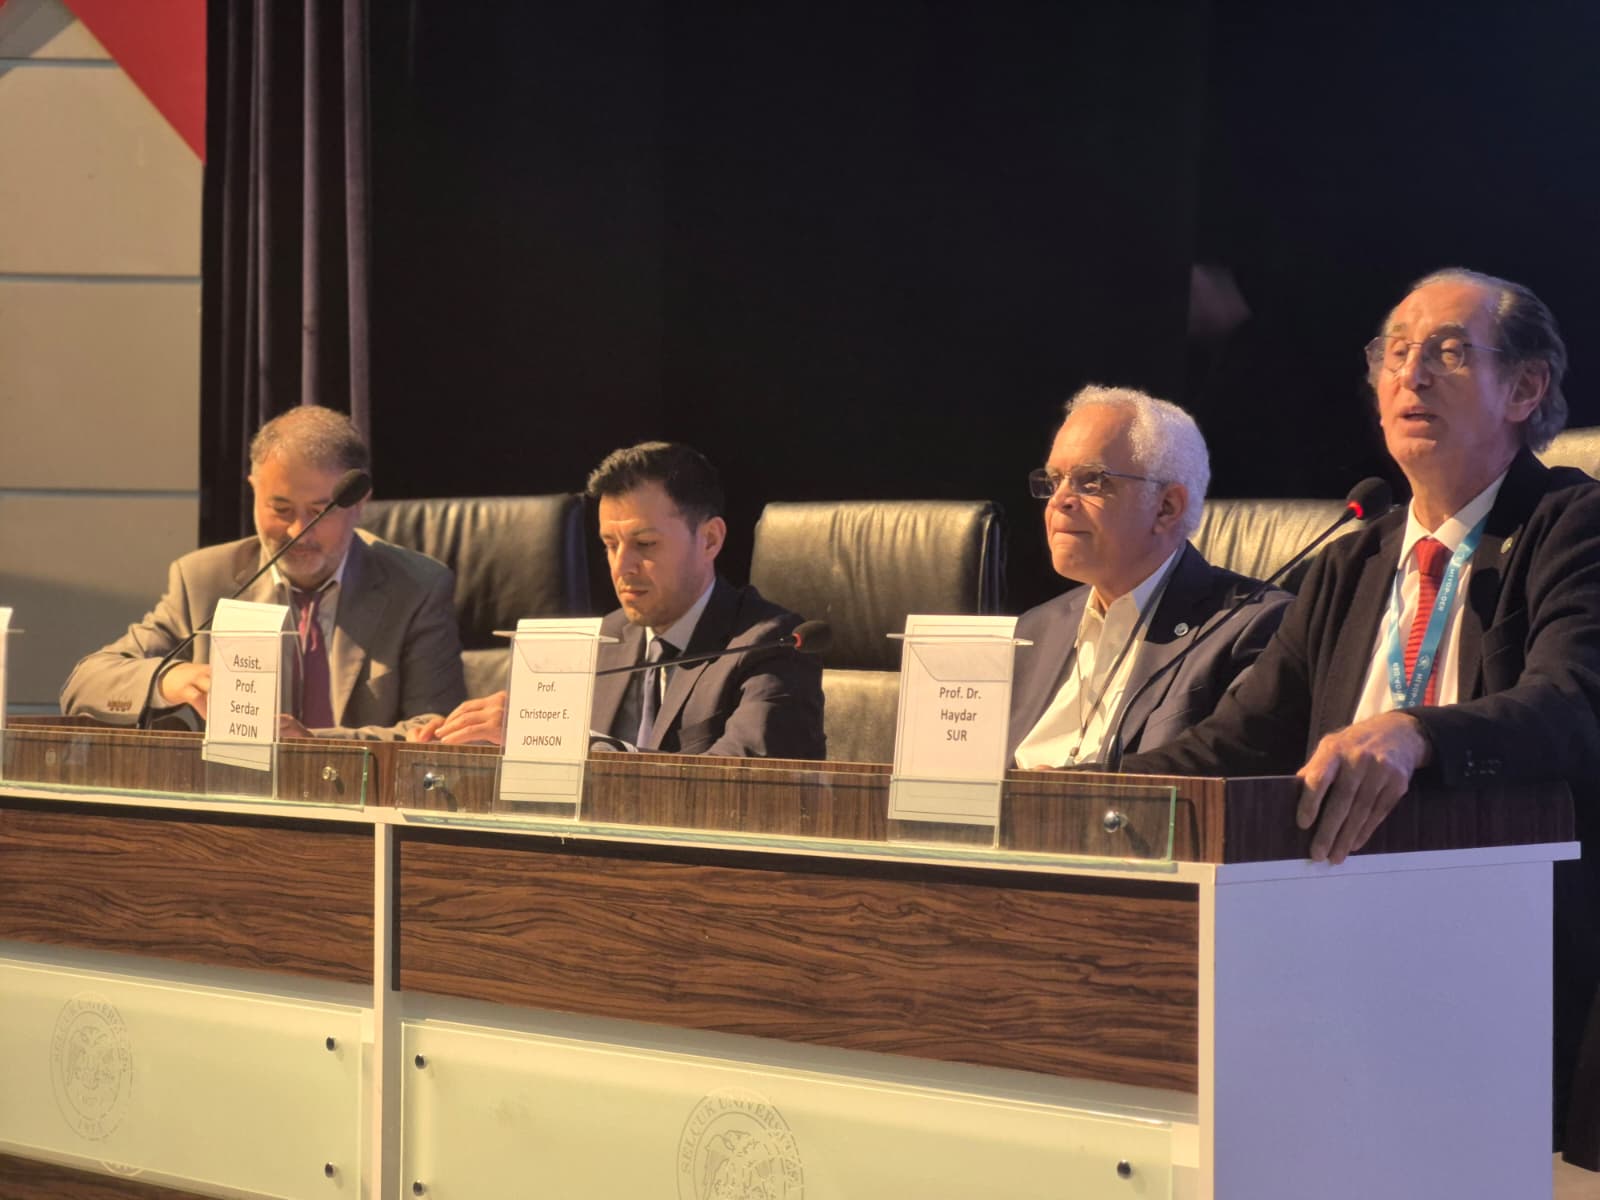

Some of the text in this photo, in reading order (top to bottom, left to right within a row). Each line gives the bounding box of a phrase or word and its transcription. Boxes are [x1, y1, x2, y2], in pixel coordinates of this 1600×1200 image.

[233, 654, 262, 670] Assist.
[235, 679, 257, 694] Prof.
[537, 682, 556, 693] Prof.
[939, 687, 982, 700] Prof. Dr.
[230, 700, 260, 717] Serdar
[519, 708, 570, 721] Christoper E.
[940, 709, 977, 724] Haydar
[228, 722, 258, 739] AYDIN
[946, 729, 968, 742] SUR
[521, 735, 562, 747] JOHNSON
